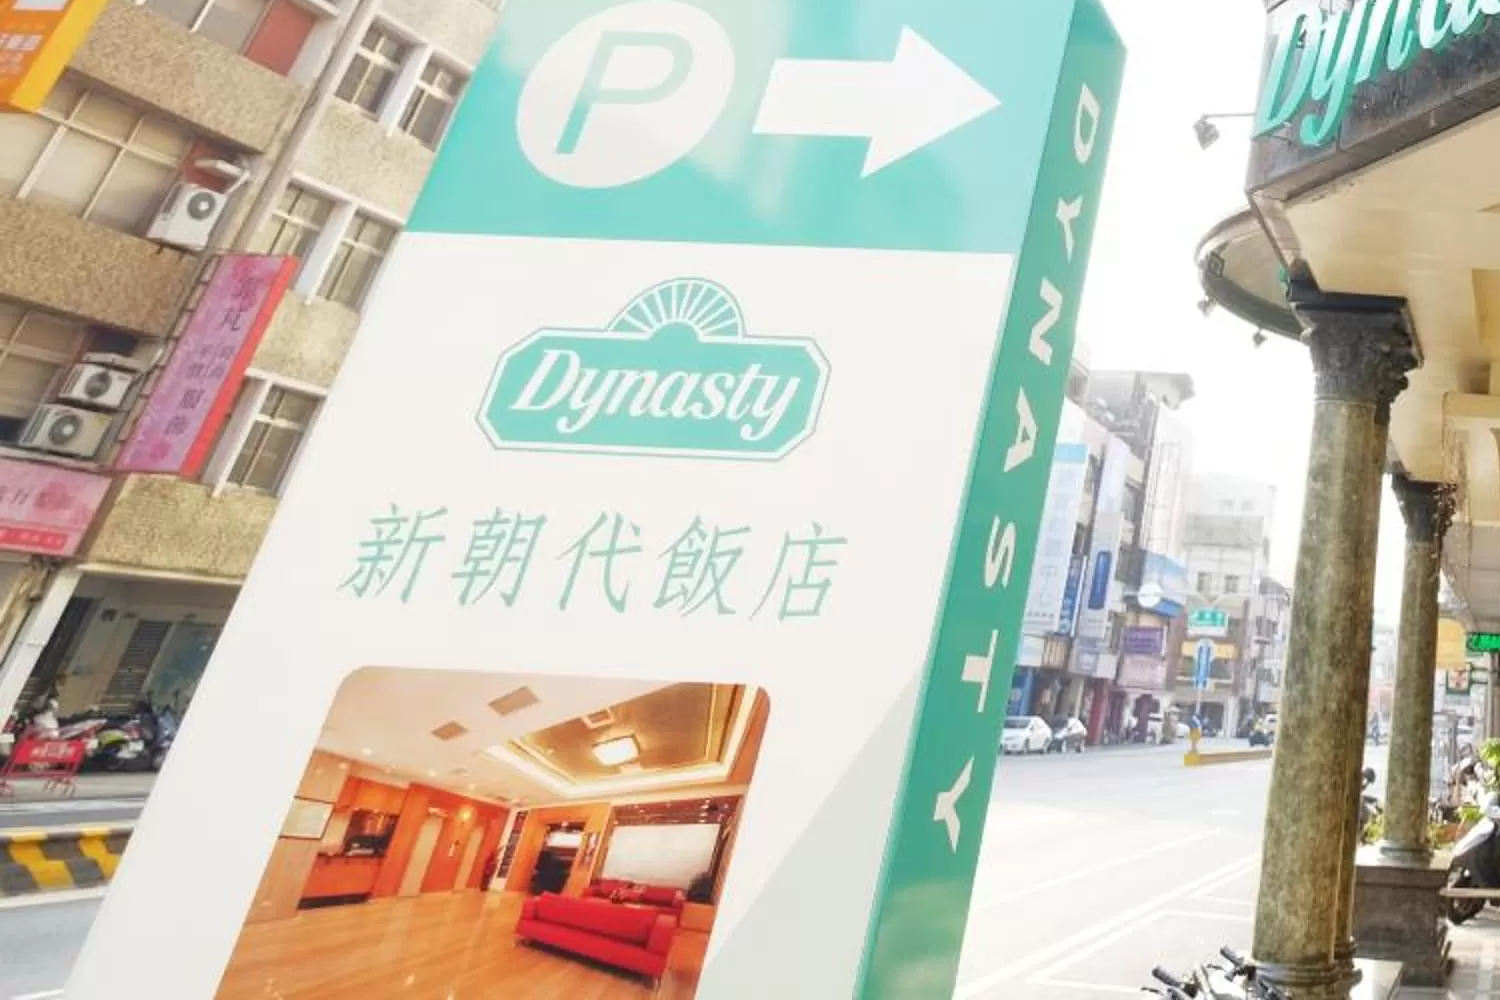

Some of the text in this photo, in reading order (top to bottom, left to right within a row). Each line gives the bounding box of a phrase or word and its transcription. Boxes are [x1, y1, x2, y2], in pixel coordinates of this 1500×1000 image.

[556, 30, 695, 157] P
[510, 348, 802, 442] Dynasty
[932, 82, 1102, 853] DYNASTY
[336, 500, 849, 624] 新朝代飯店
